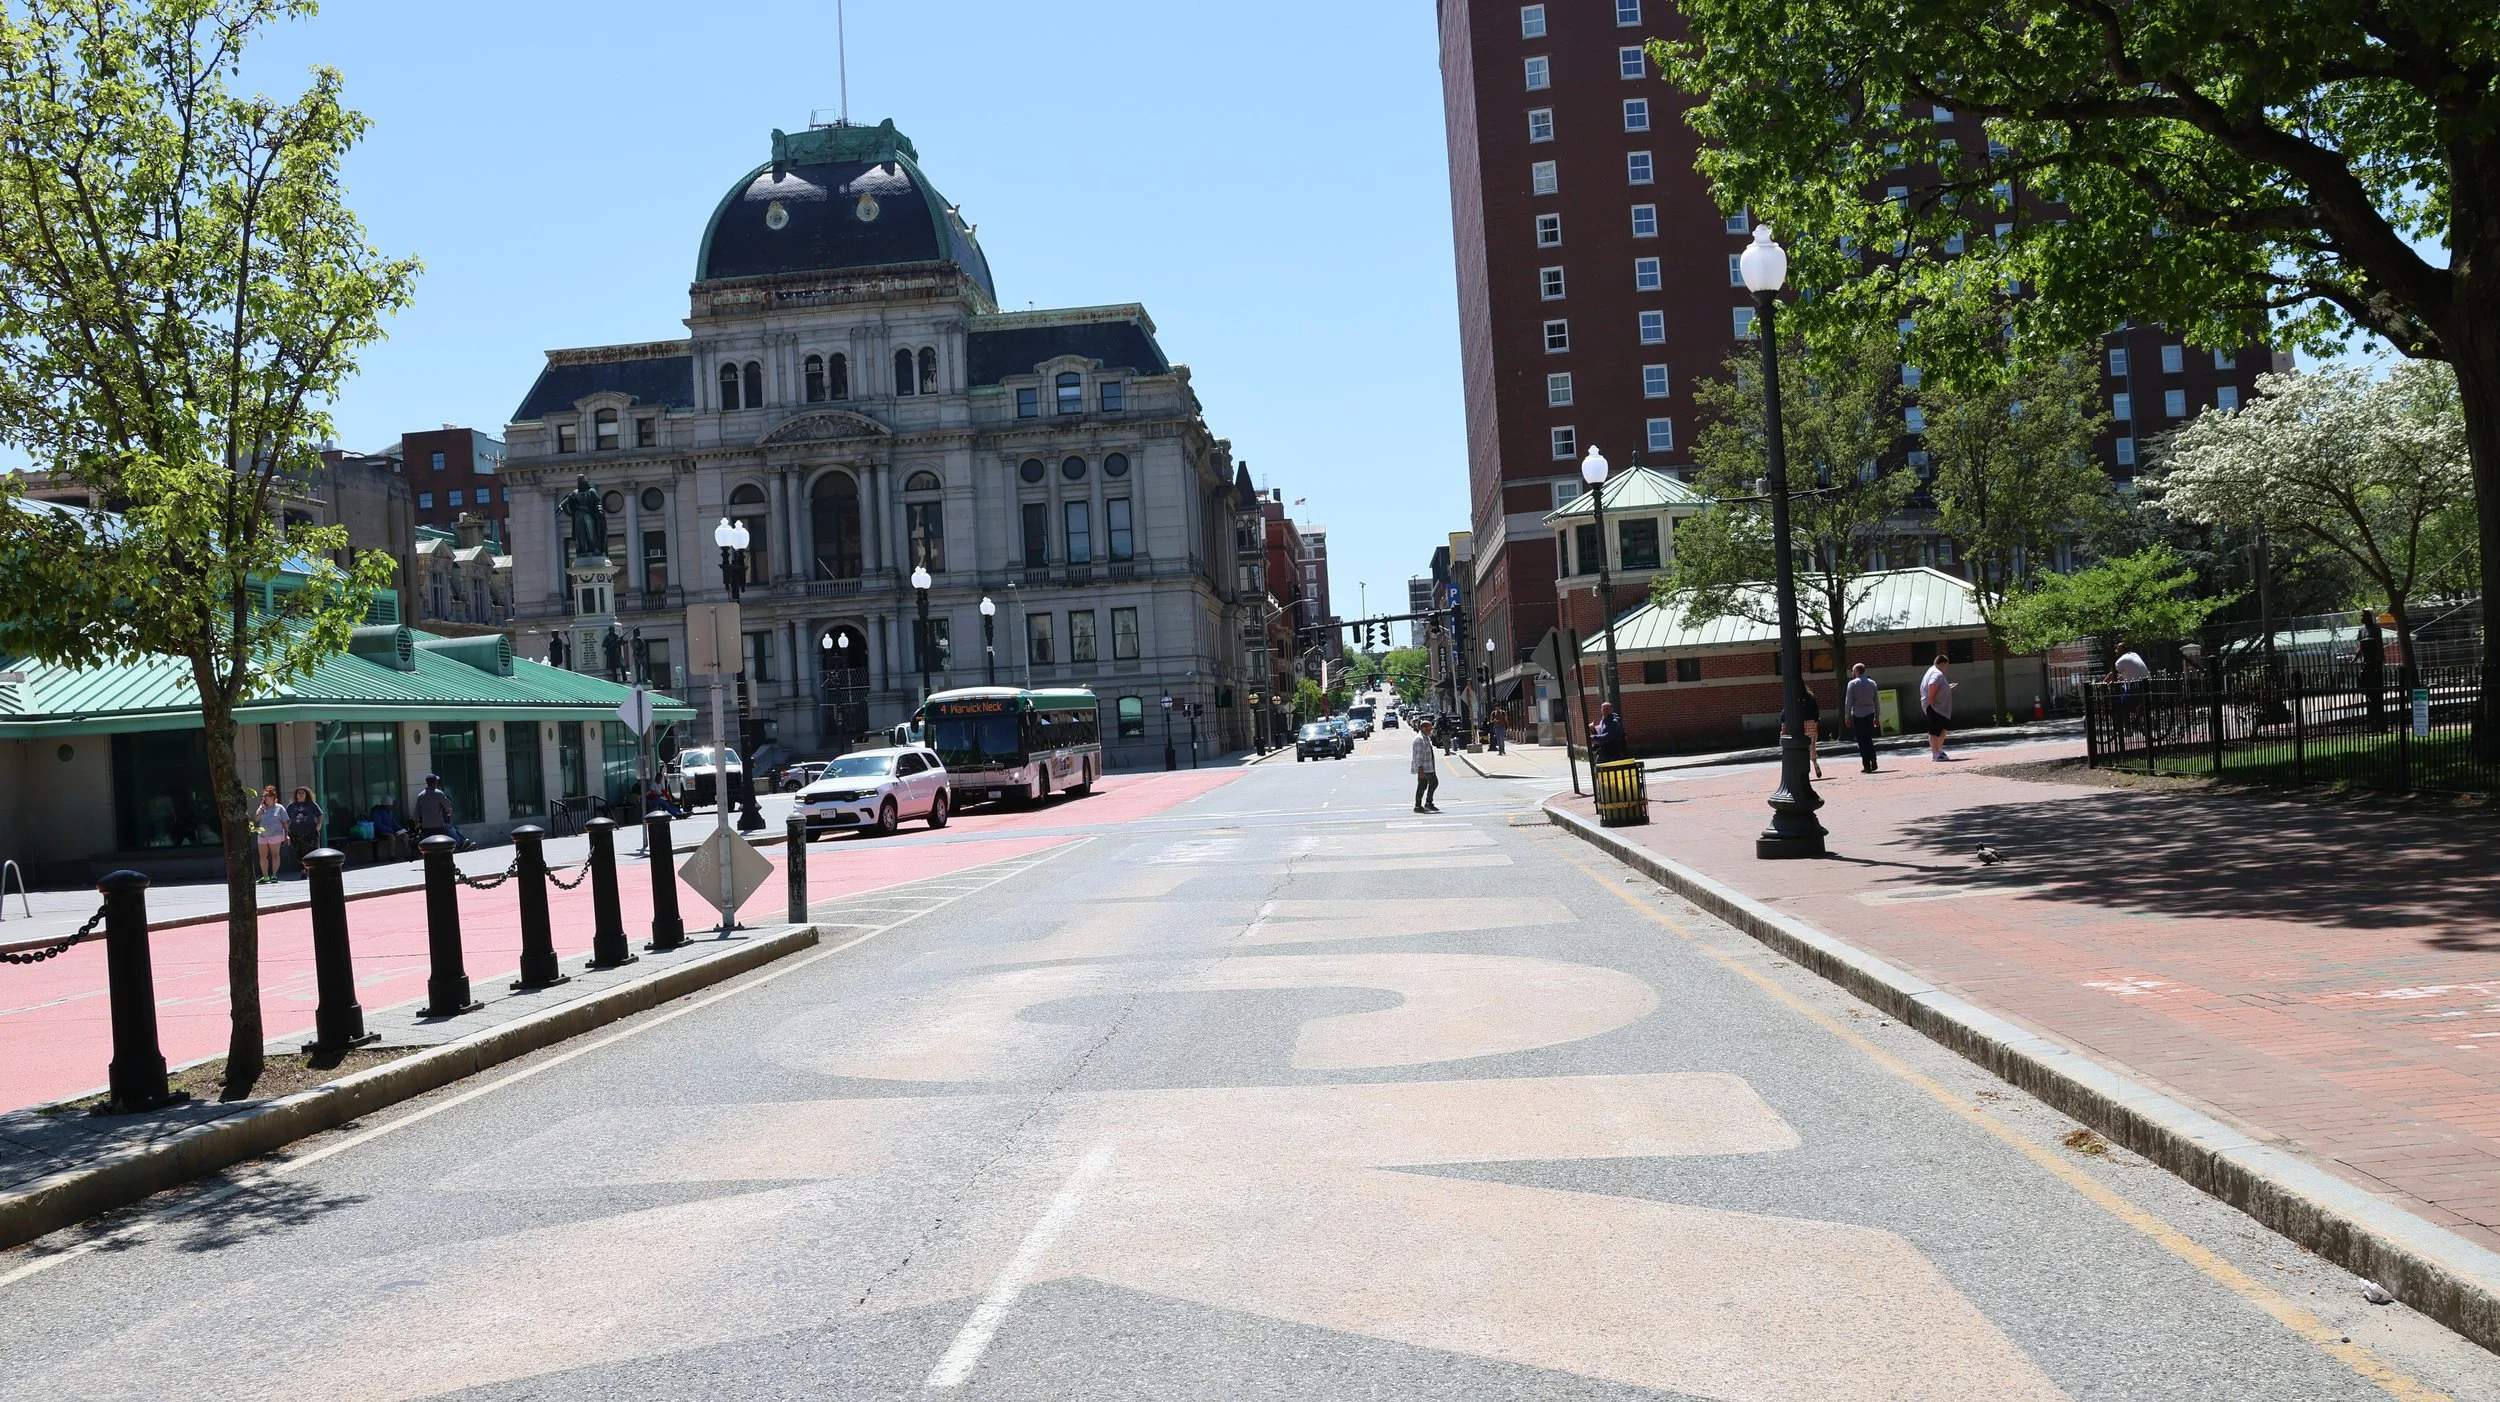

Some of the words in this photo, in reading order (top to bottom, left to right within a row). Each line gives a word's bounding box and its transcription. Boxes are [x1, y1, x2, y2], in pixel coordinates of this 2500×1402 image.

[940, 704, 947, 714] 4
[950, 703, 982, 715] Warwick
[982, 701, 1002, 712] Neck
